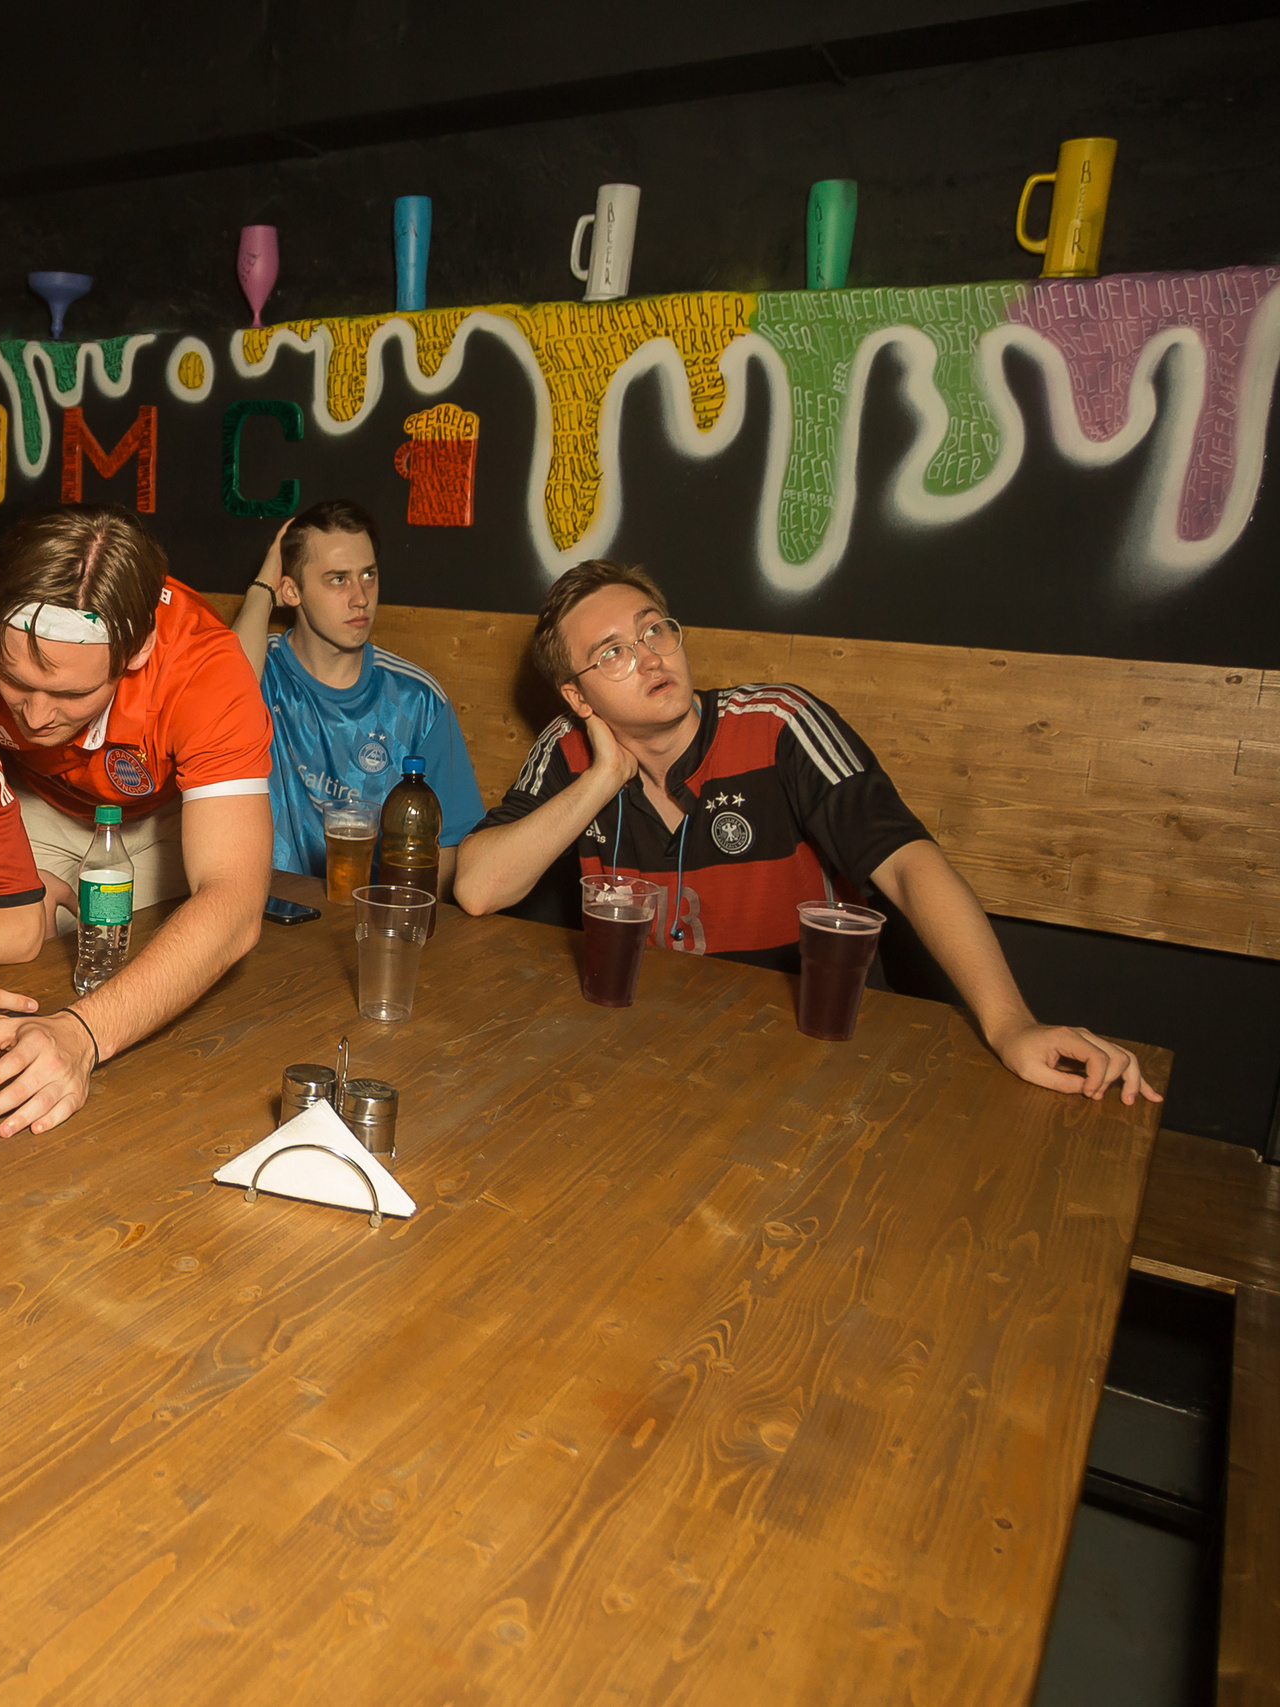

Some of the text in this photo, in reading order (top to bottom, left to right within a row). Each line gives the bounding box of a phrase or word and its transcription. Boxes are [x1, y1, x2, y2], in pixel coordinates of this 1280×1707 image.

[696, 294, 750, 328] BEER
[920, 284, 976, 323] BEER
[975, 283, 1035, 328] BEER
[1034, 283, 1097, 330] BEER
[1094, 279, 1158, 321] BEER
[1157, 273, 1219, 317] BEER
[758, 323, 820, 355] BEER
[922, 321, 978, 357] BEER
[552, 401, 589, 433] BEER
[793, 386, 841, 425] BEER
[793, 418, 838, 460] BEER
[944, 416, 999, 462] BEER
[786, 453, 836, 496] BEER
[928, 450, 986, 488] BEER
[297, 764, 360, 799] Saltire
